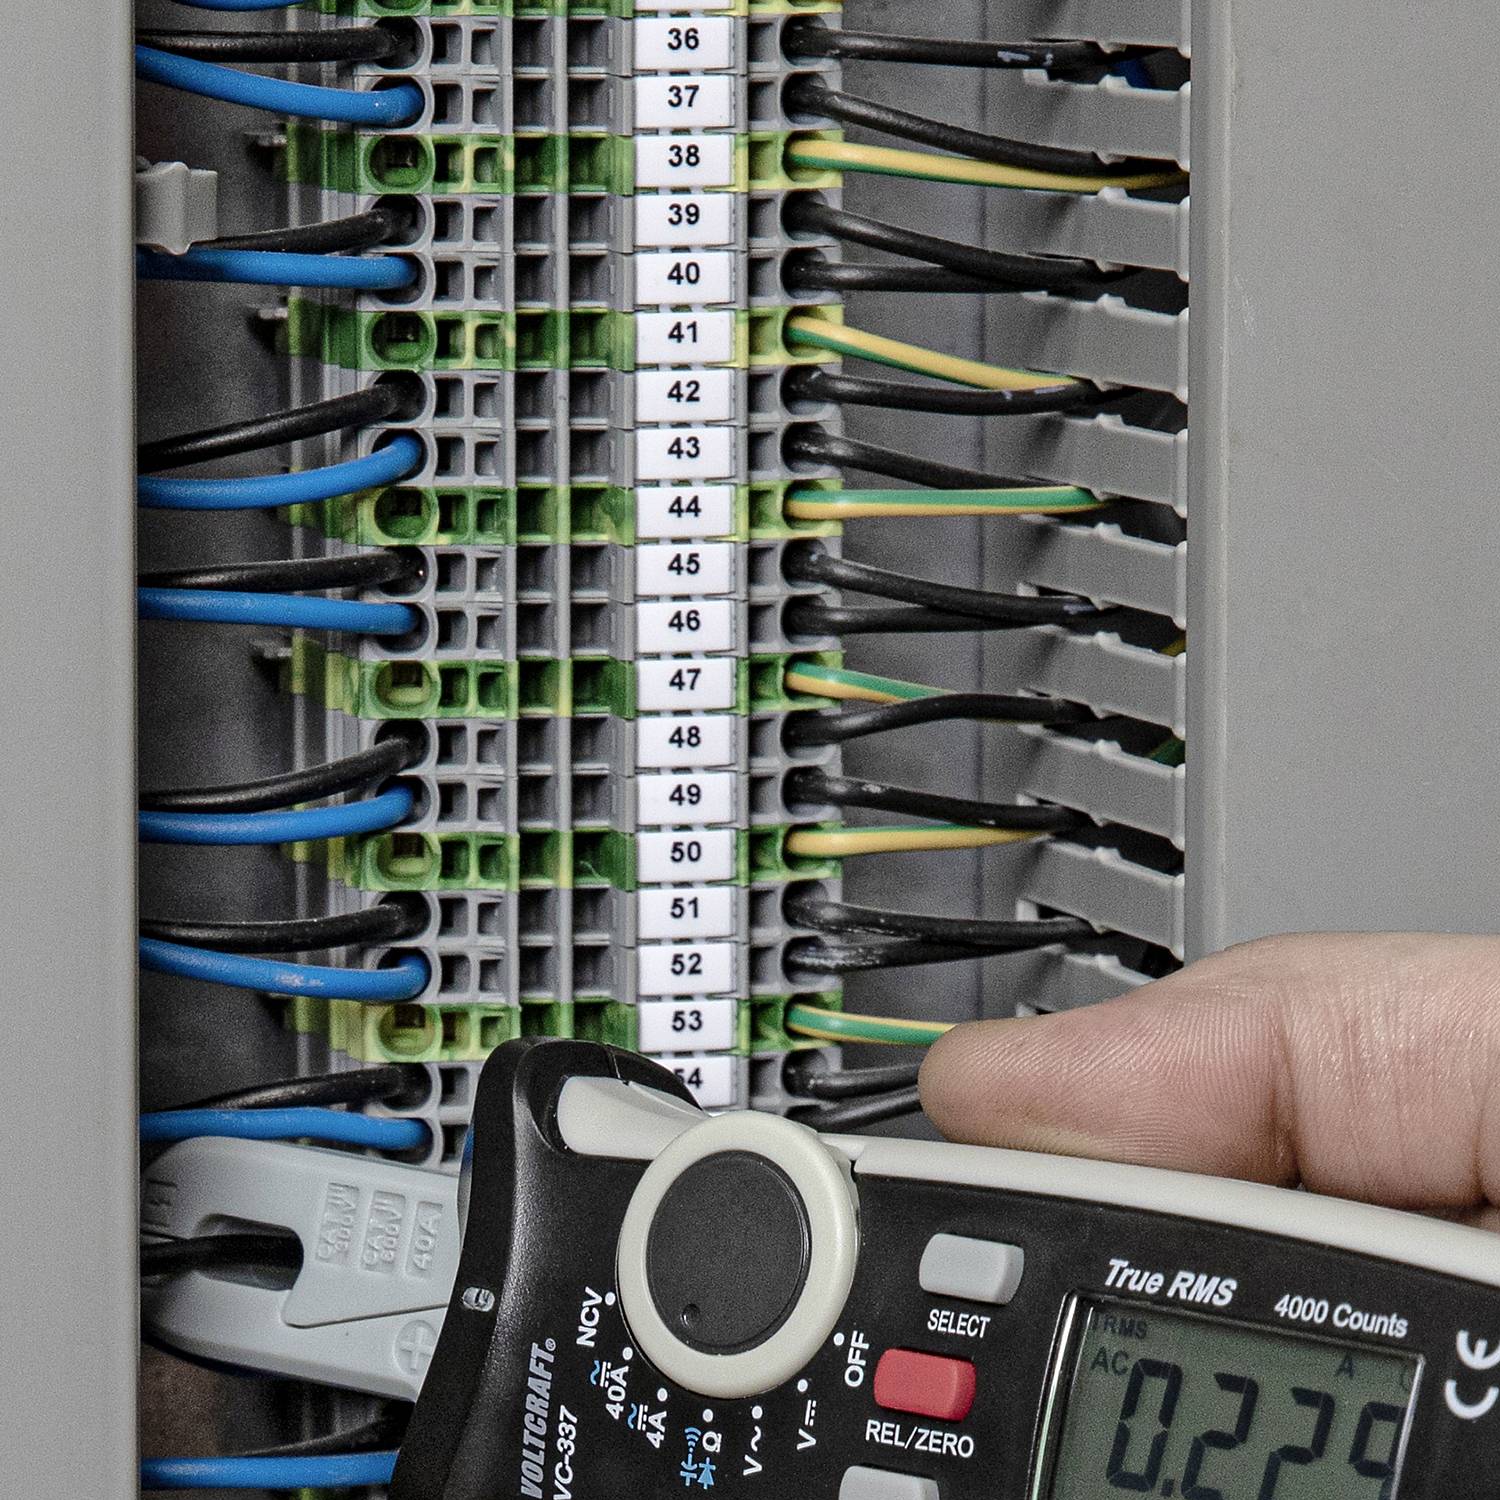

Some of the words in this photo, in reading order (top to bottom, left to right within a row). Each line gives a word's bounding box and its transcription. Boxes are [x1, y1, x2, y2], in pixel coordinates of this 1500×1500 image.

[667, 27, 700, 51] 36
[667, 84, 700, 108] 37
[668, 144, 701, 168] 38
[668, 202, 700, 226] 39
[667, 261, 701, 286] 40
[667, 321, 698, 344] 41
[667, 380, 701, 403] 42
[667, 436, 701, 460] 43
[668, 495, 702, 518] 44
[667, 552, 701, 576] 45
[668, 609, 701, 633] 46
[668, 667, 702, 691] 47
[668, 725, 702, 749] 48
[668, 783, 702, 806] 49
[670, 840, 702, 864] 50
[670, 896, 699, 920] 51
[670, 952, 703, 976] 52
[671, 1009, 703, 1033] 53
[1104, 1258, 1164, 1294] True
[1167, 1270, 1238, 1306] RMS
[576, 1286, 603, 1347] NCV
[927, 1308, 990, 1338] SELECT
[1274, 1294, 1329, 1324] 4000
[1332, 1302, 1408, 1339] Counts
[844, 1330, 869, 1387] OFF
[1090, 1346, 1129, 1375] AC
[1336, 1352, 1355, 1378] A
[605, 1365, 629, 1420] 40A
[646, 1410, 668, 1449] 4A
[865, 1419, 974, 1459] REL/ZERO
[553, 1405, 578, 1500] VC-337
